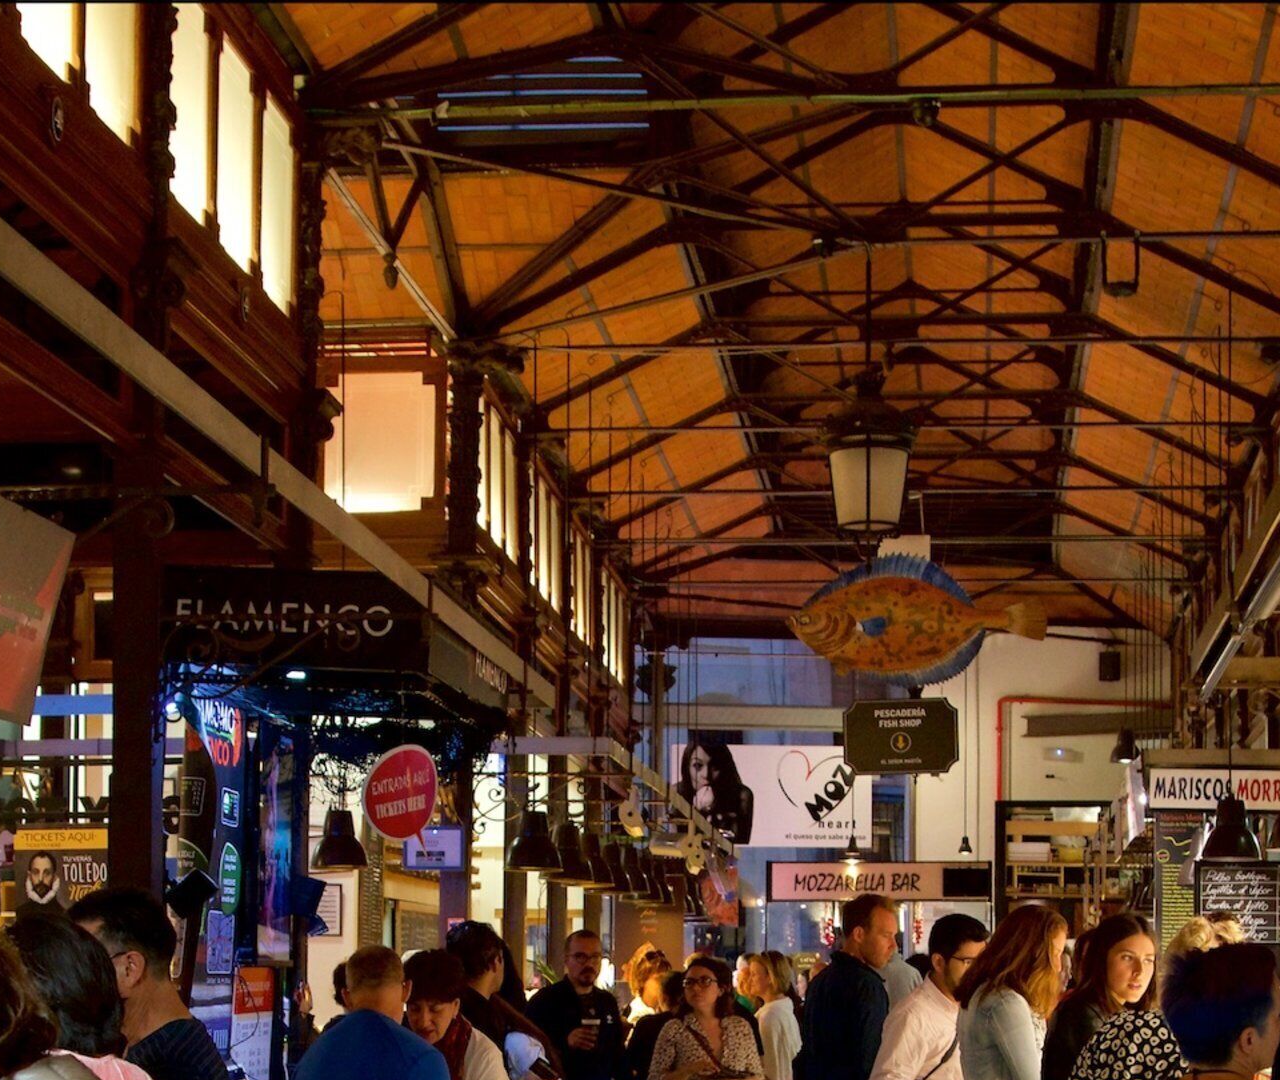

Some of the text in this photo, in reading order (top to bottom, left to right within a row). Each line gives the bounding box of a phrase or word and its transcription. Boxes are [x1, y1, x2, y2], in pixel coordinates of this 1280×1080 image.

[176, 598, 394, 638] FLAMENCO
[873, 706, 927, 718] PESCADERÍA
[878, 718, 922, 728] FISH SHOP
[375, 794, 426, 820] TICKETS HERE
[818, 819, 857, 829] heart
[24, 832, 67, 843] TICKETS
[62, 862, 108, 882] TOLEDO
[793, 873, 921, 892] MOZZARELLA BAR
